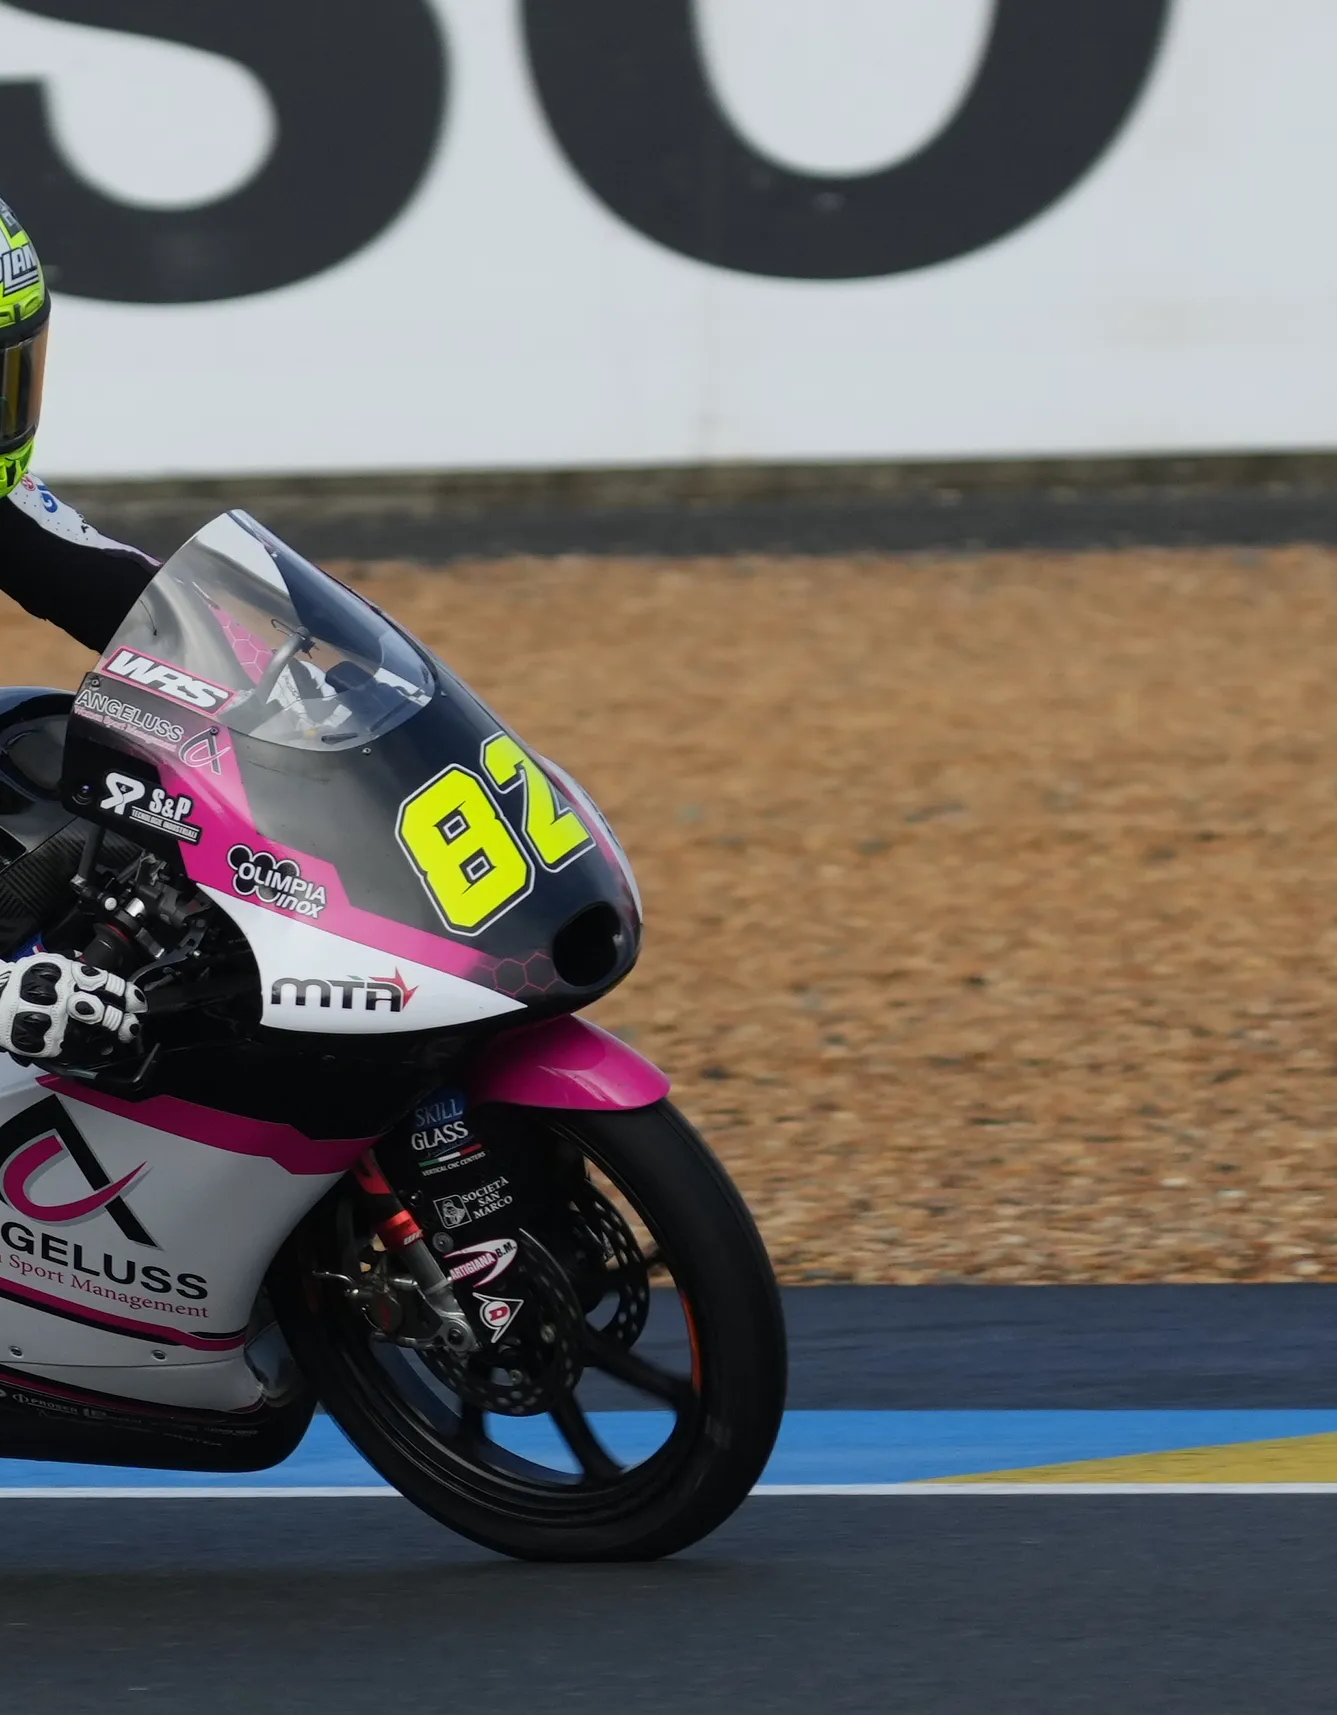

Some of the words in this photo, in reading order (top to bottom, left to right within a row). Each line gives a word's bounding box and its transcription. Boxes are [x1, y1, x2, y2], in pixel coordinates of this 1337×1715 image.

[106, 650, 230, 708] WRS
[74, 705, 103, 724] Women
[103, 716, 126, 731] Sport
[75, 689, 185, 743] ANGELUSS
[148, 788, 192, 822] S&P
[396, 731, 596, 937] 82
[238, 862, 327, 904] OLIMPIA
[415, 1098, 463, 1127] SKILL
[411, 1120, 469, 1150] GLASS
[447, 1161, 461, 1171] CNC
[460, 1151, 486, 1166] CENTERS
[472, 1195, 513, 1219] MARCO
[477, 1190, 501, 1207] SAN
[449, 1252, 496, 1281] ARTIGIANA
[496, 1241, 517, 1258] B.M.
[8, 1255, 64, 1286] Sport
[70, 1275, 210, 1319] Management
